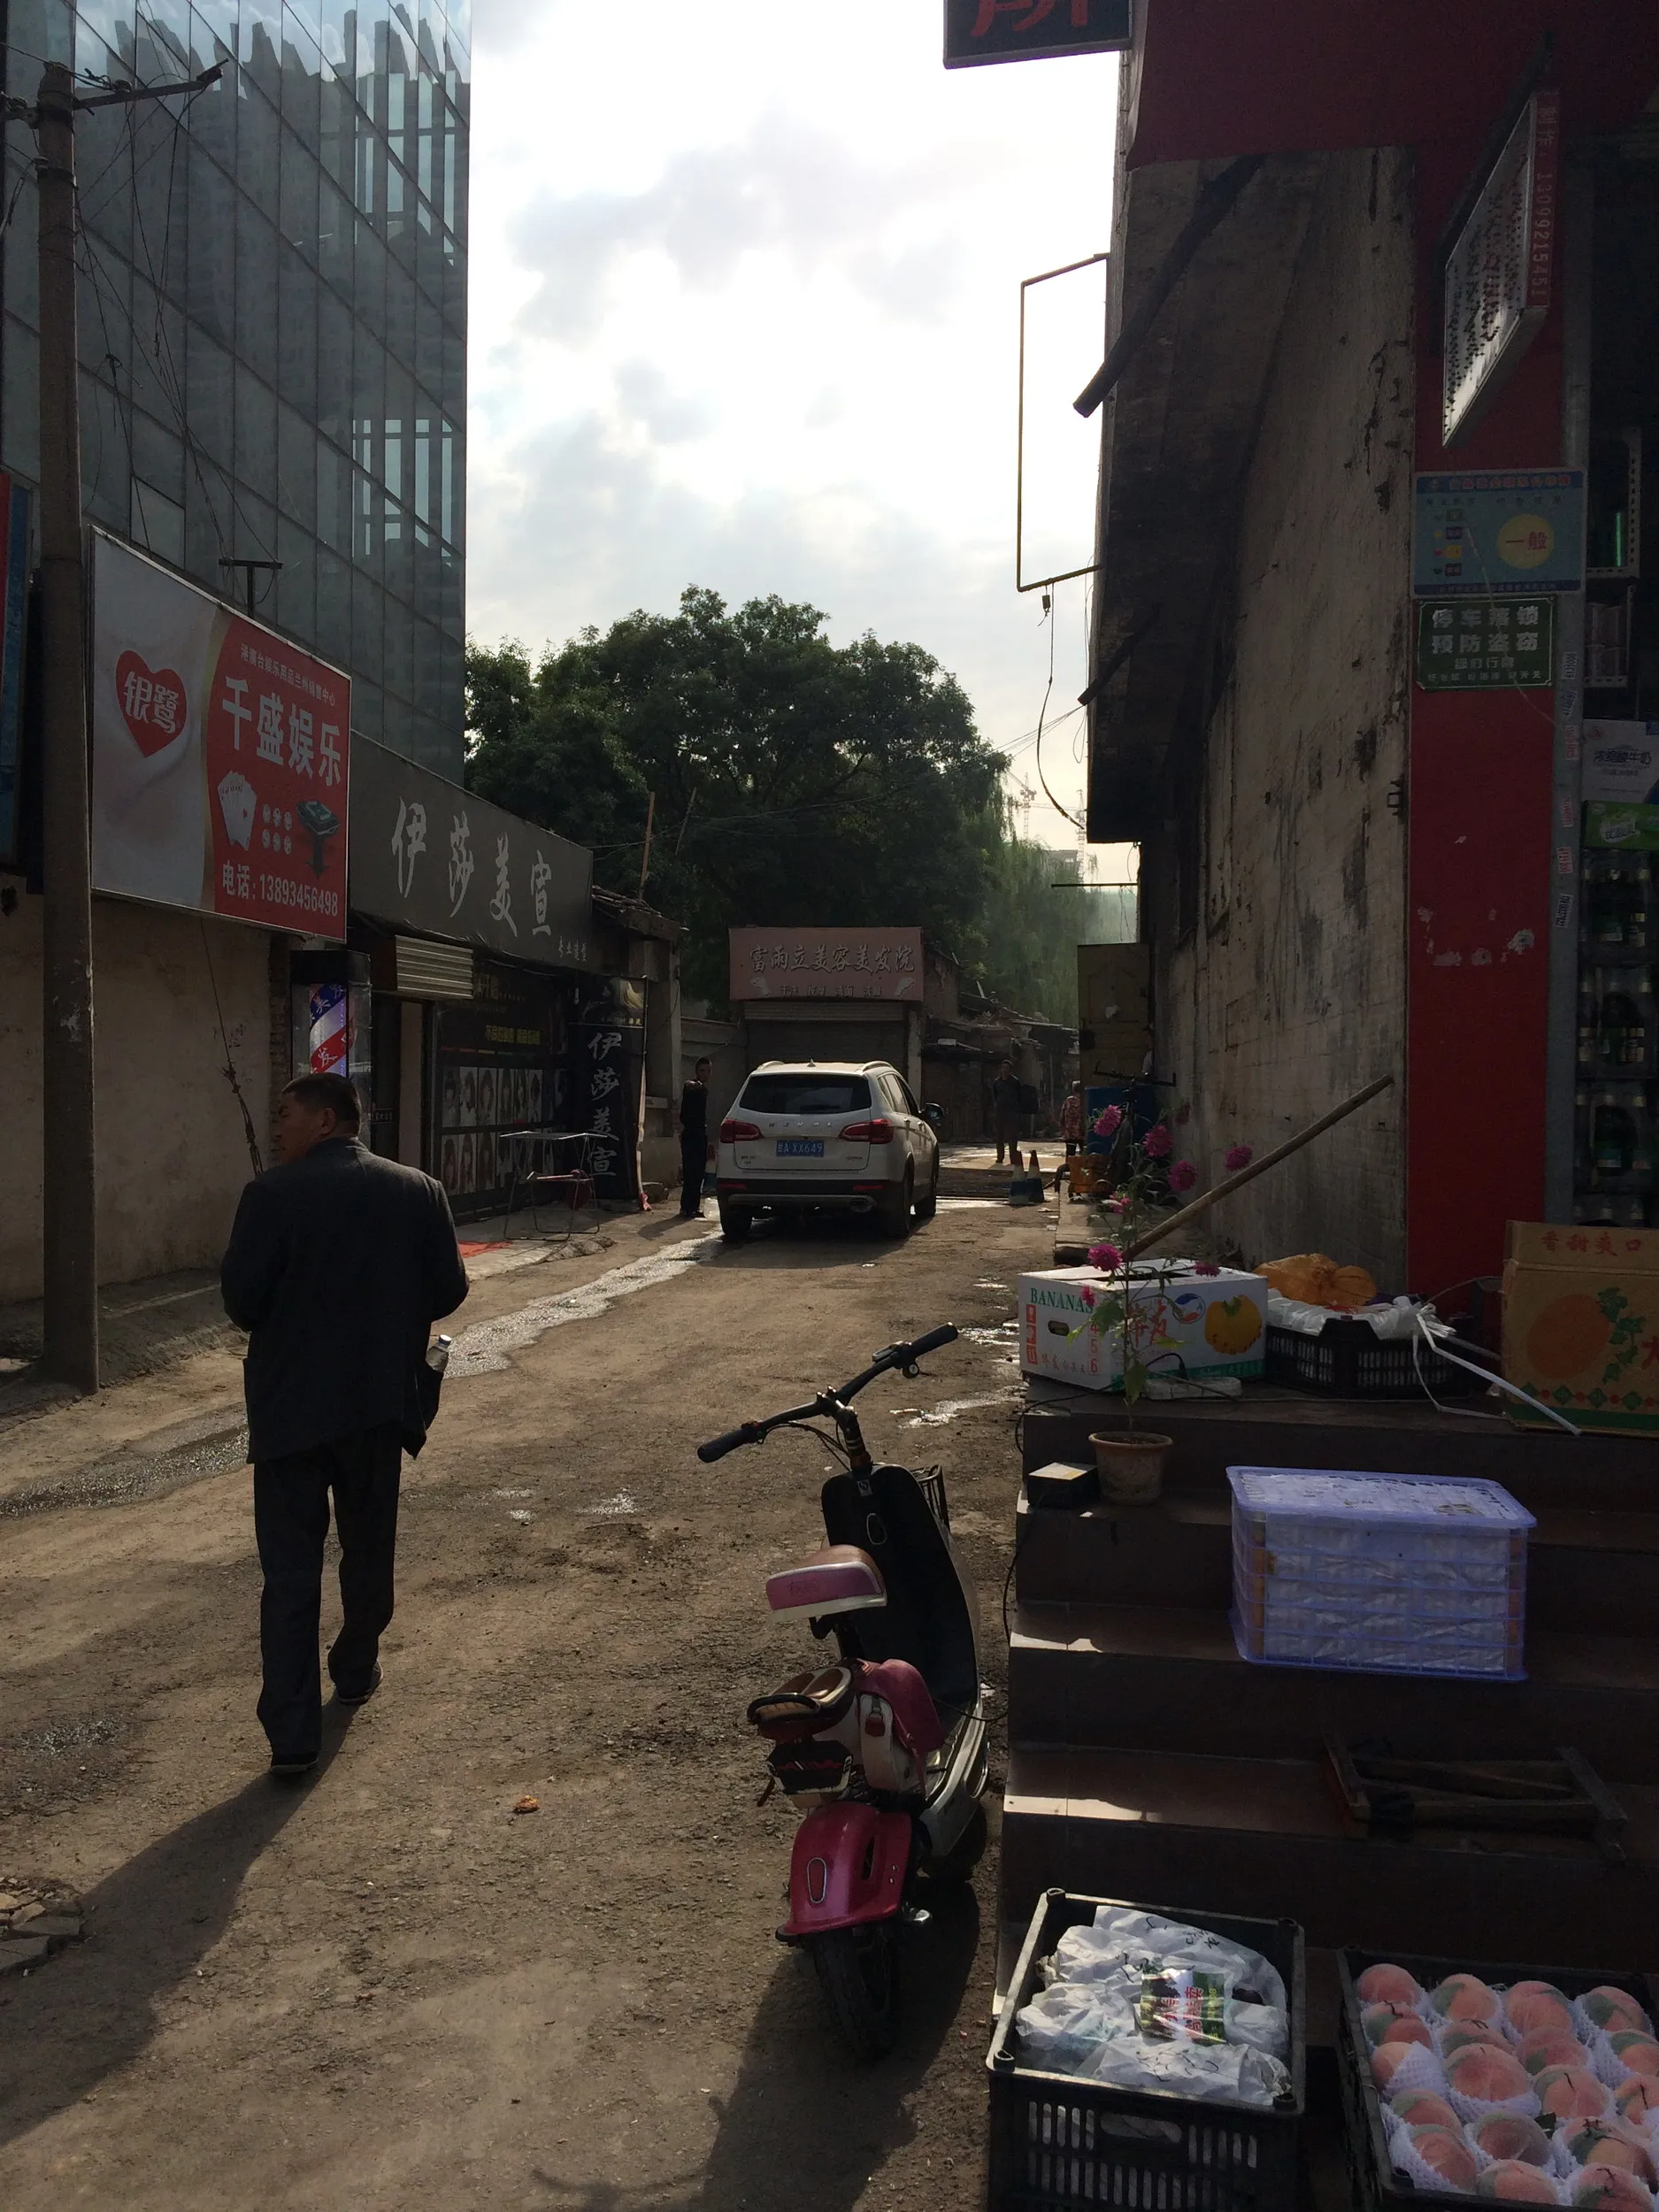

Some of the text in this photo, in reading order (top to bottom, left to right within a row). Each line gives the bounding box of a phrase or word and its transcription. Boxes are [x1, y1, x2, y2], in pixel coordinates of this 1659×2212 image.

[1506, 531, 1548, 550] 一般
[123, 671, 180, 733] 银鹭
[222, 675, 342, 787] 千盛娱乐
[1540, 1231, 1643, 1256] 香甜爽口
[1090, 1358, 1098, 1373] 6
